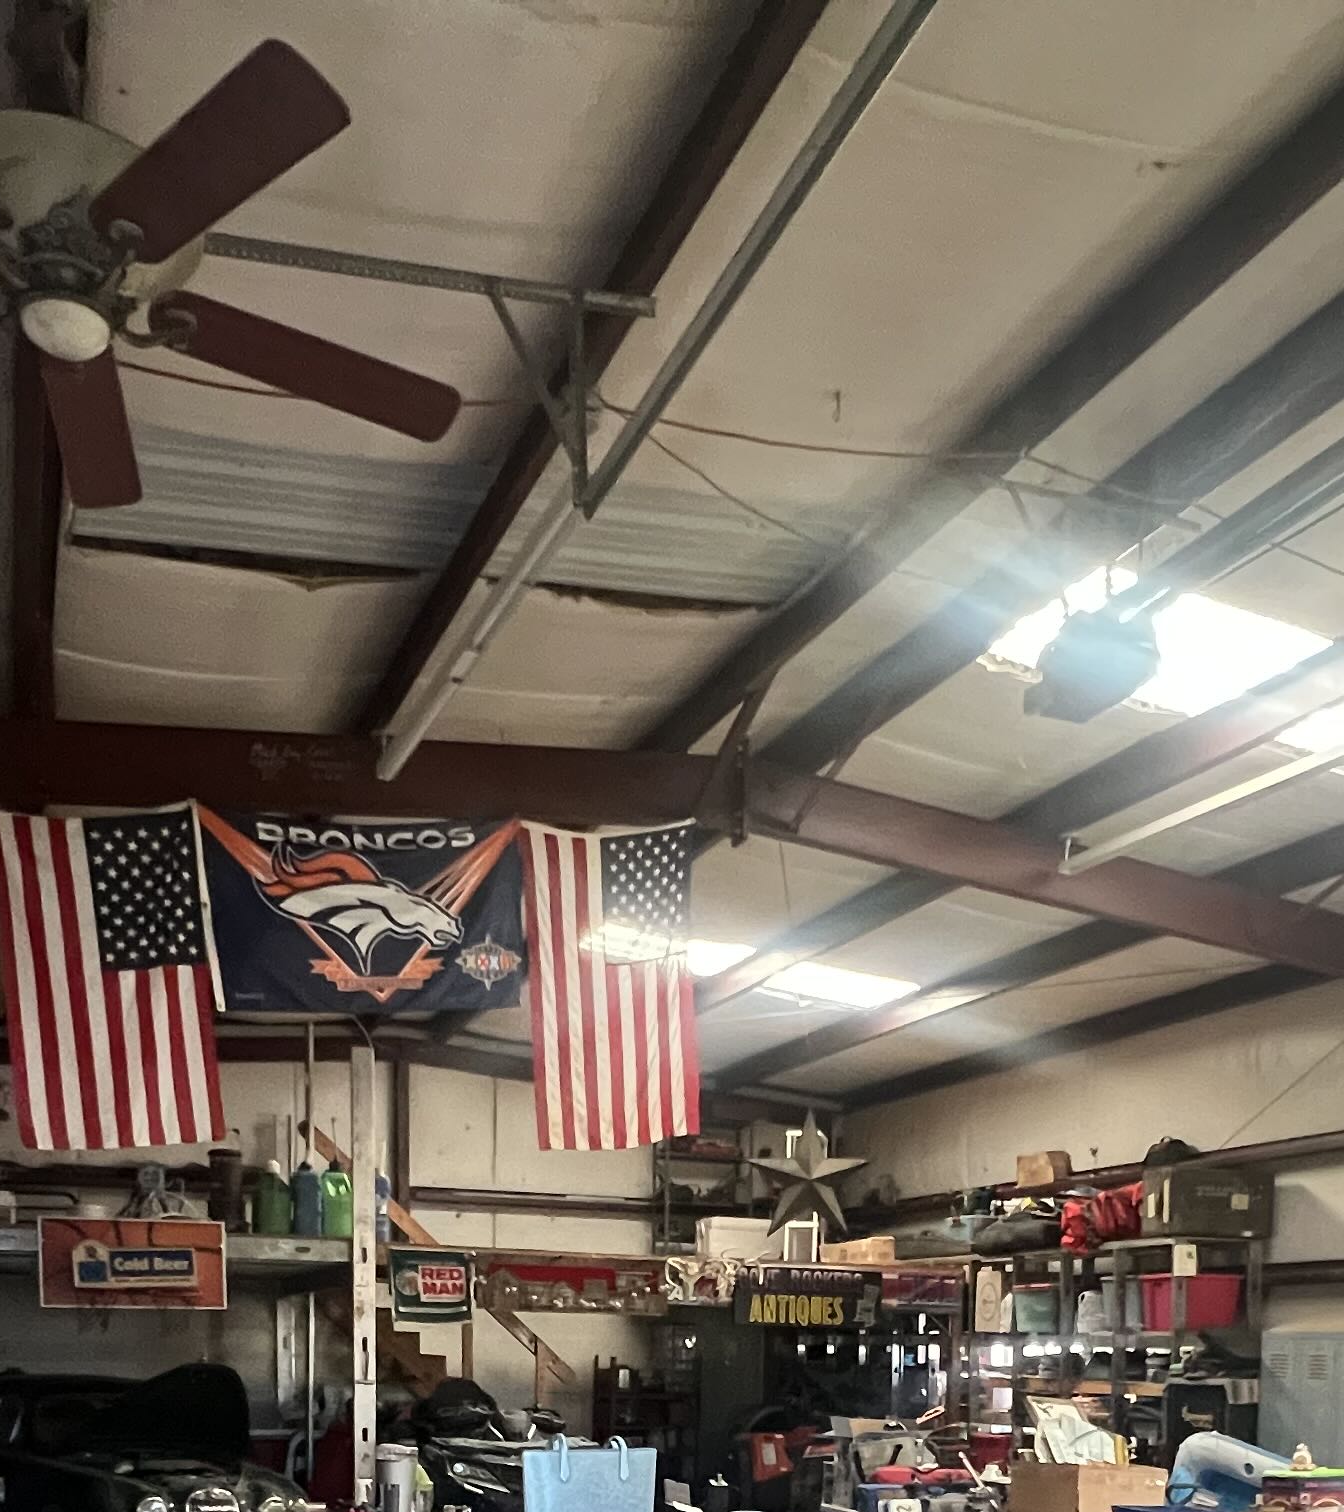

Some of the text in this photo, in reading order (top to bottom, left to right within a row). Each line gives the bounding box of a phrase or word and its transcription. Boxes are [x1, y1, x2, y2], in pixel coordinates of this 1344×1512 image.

[256, 821, 476, 851] BRONCOS
[113, 1256, 190, 1271] Cold Beer
[420, 1267, 464, 1281] RED
[422, 1281, 465, 1296] MAN
[749, 1294, 844, 1326] ANTIQUES
